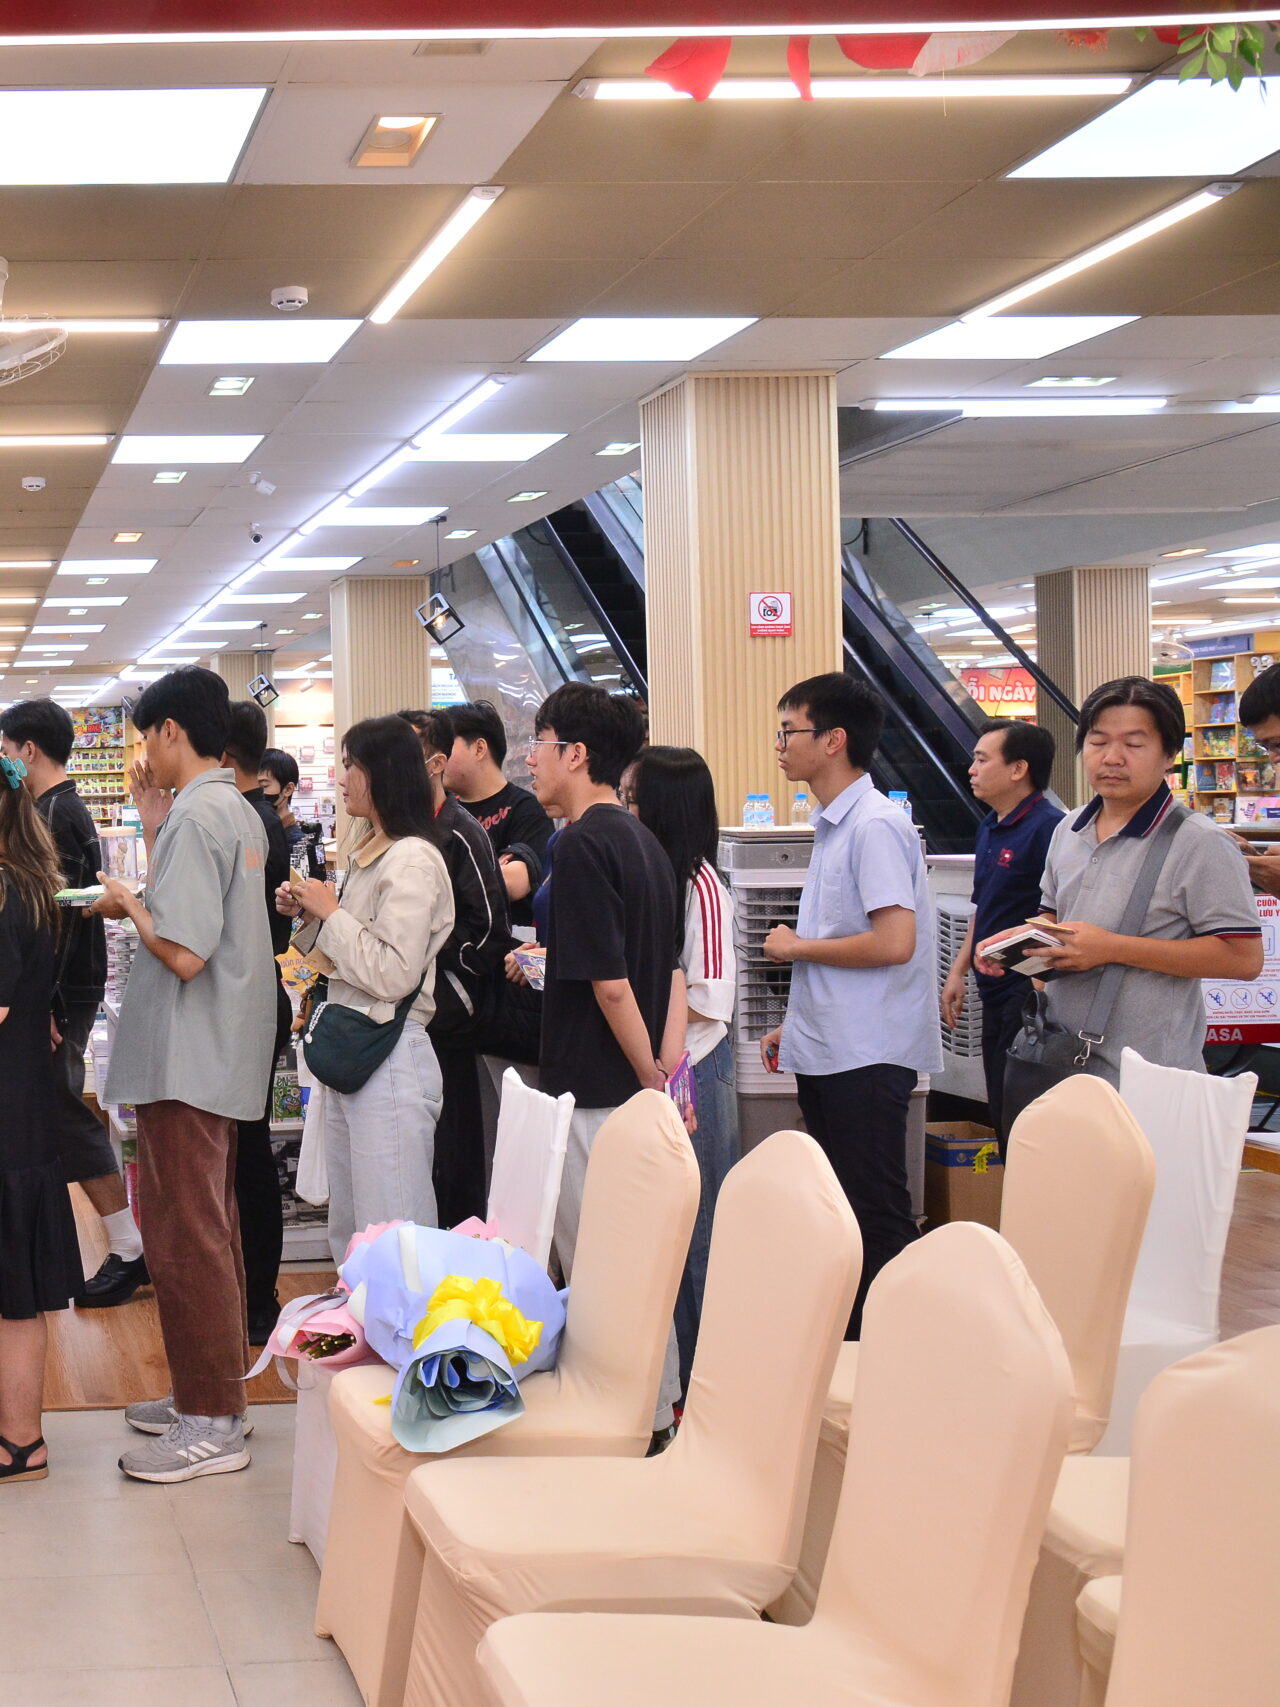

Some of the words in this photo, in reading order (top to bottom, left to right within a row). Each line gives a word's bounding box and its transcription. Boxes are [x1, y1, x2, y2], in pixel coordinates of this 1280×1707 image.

[967, 677, 985, 700] ỖI
[989, 681, 1036, 701] NGÀY
[1207, 1028, 1243, 1042] ASA
